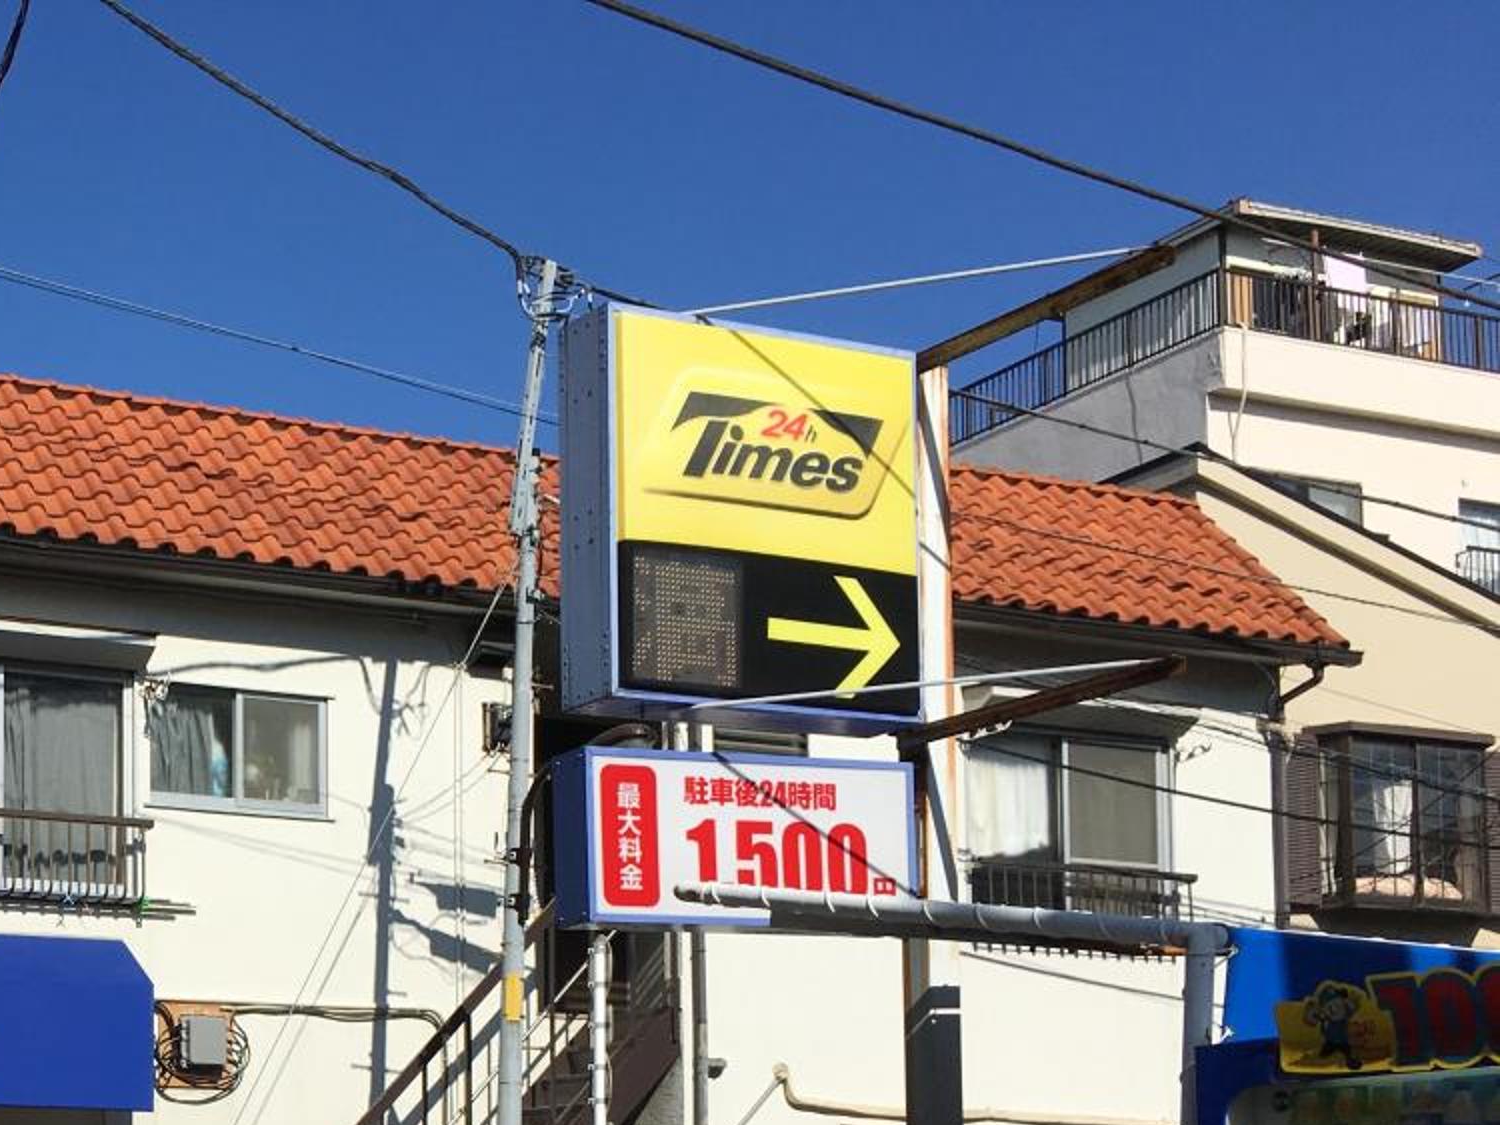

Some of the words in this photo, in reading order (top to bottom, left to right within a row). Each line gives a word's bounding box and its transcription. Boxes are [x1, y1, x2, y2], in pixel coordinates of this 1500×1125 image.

[671, 390, 883, 496] Times
[760, 408, 818, 443] 24h
[683, 775, 837, 812] 駐車後24時間
[616, 782, 645, 892] 最大料金
